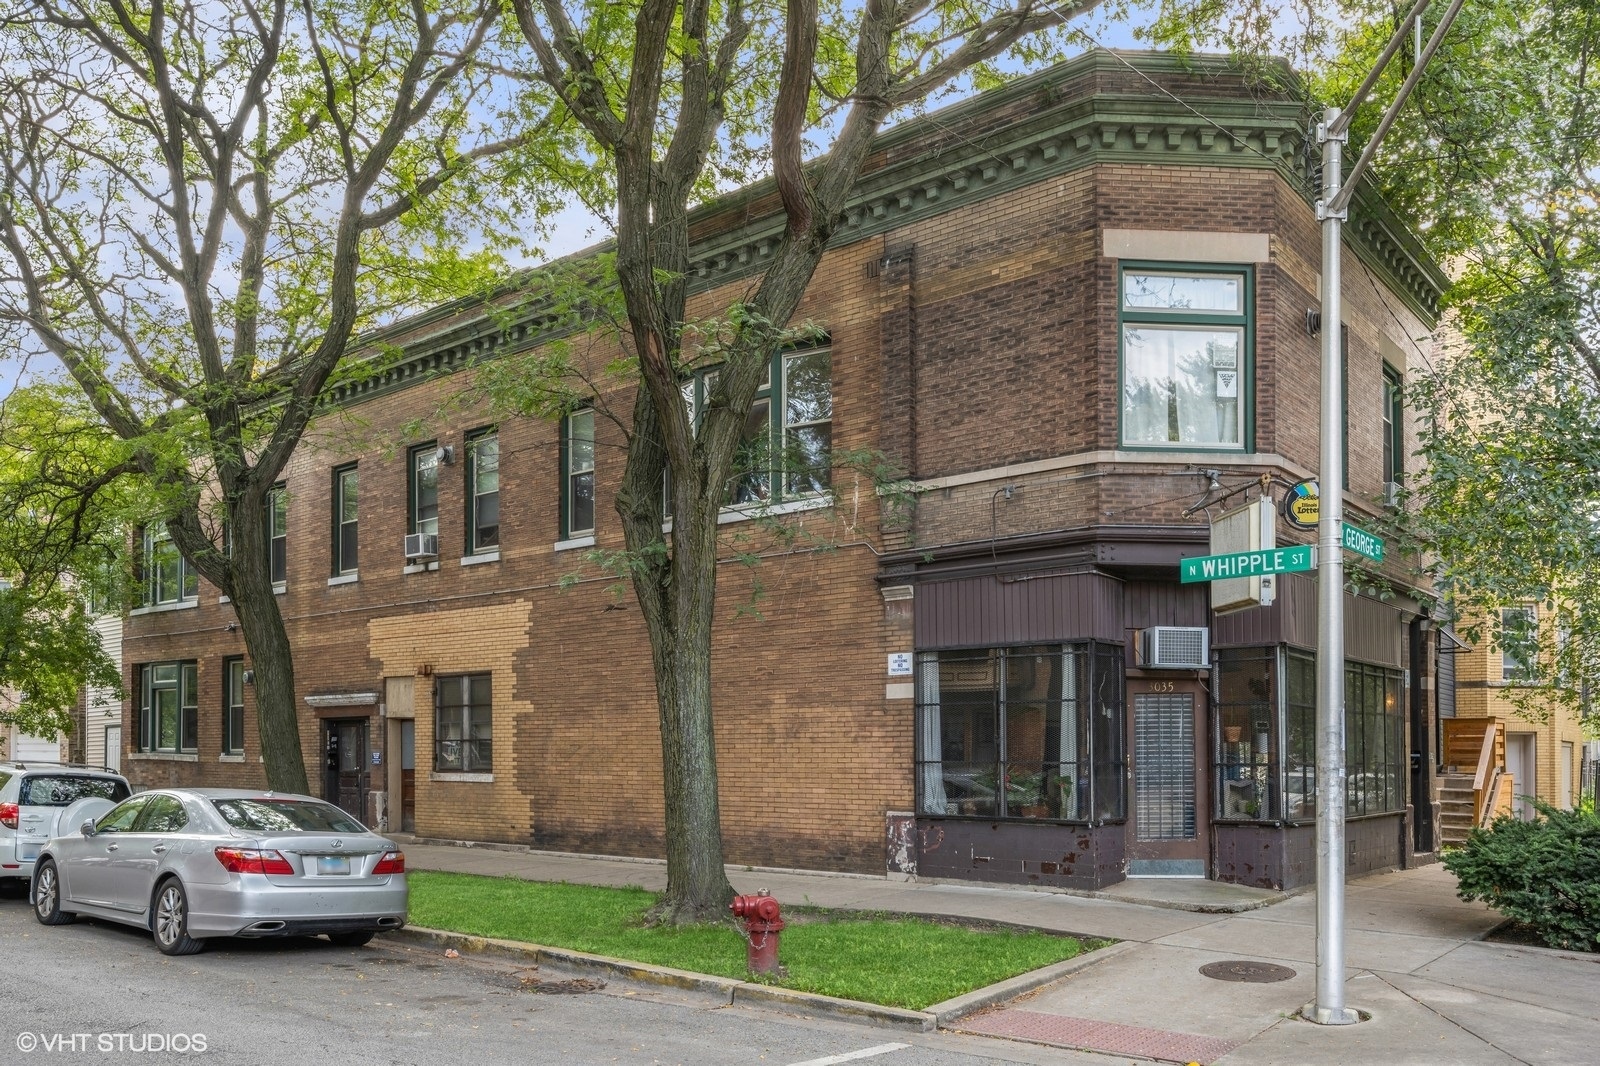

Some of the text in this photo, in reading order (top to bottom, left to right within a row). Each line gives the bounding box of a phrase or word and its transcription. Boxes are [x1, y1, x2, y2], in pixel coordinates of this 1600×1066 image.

[1346, 527, 1381, 557] GEORGE ST
[1189, 551, 1304, 578] N WHIPPLE ST
